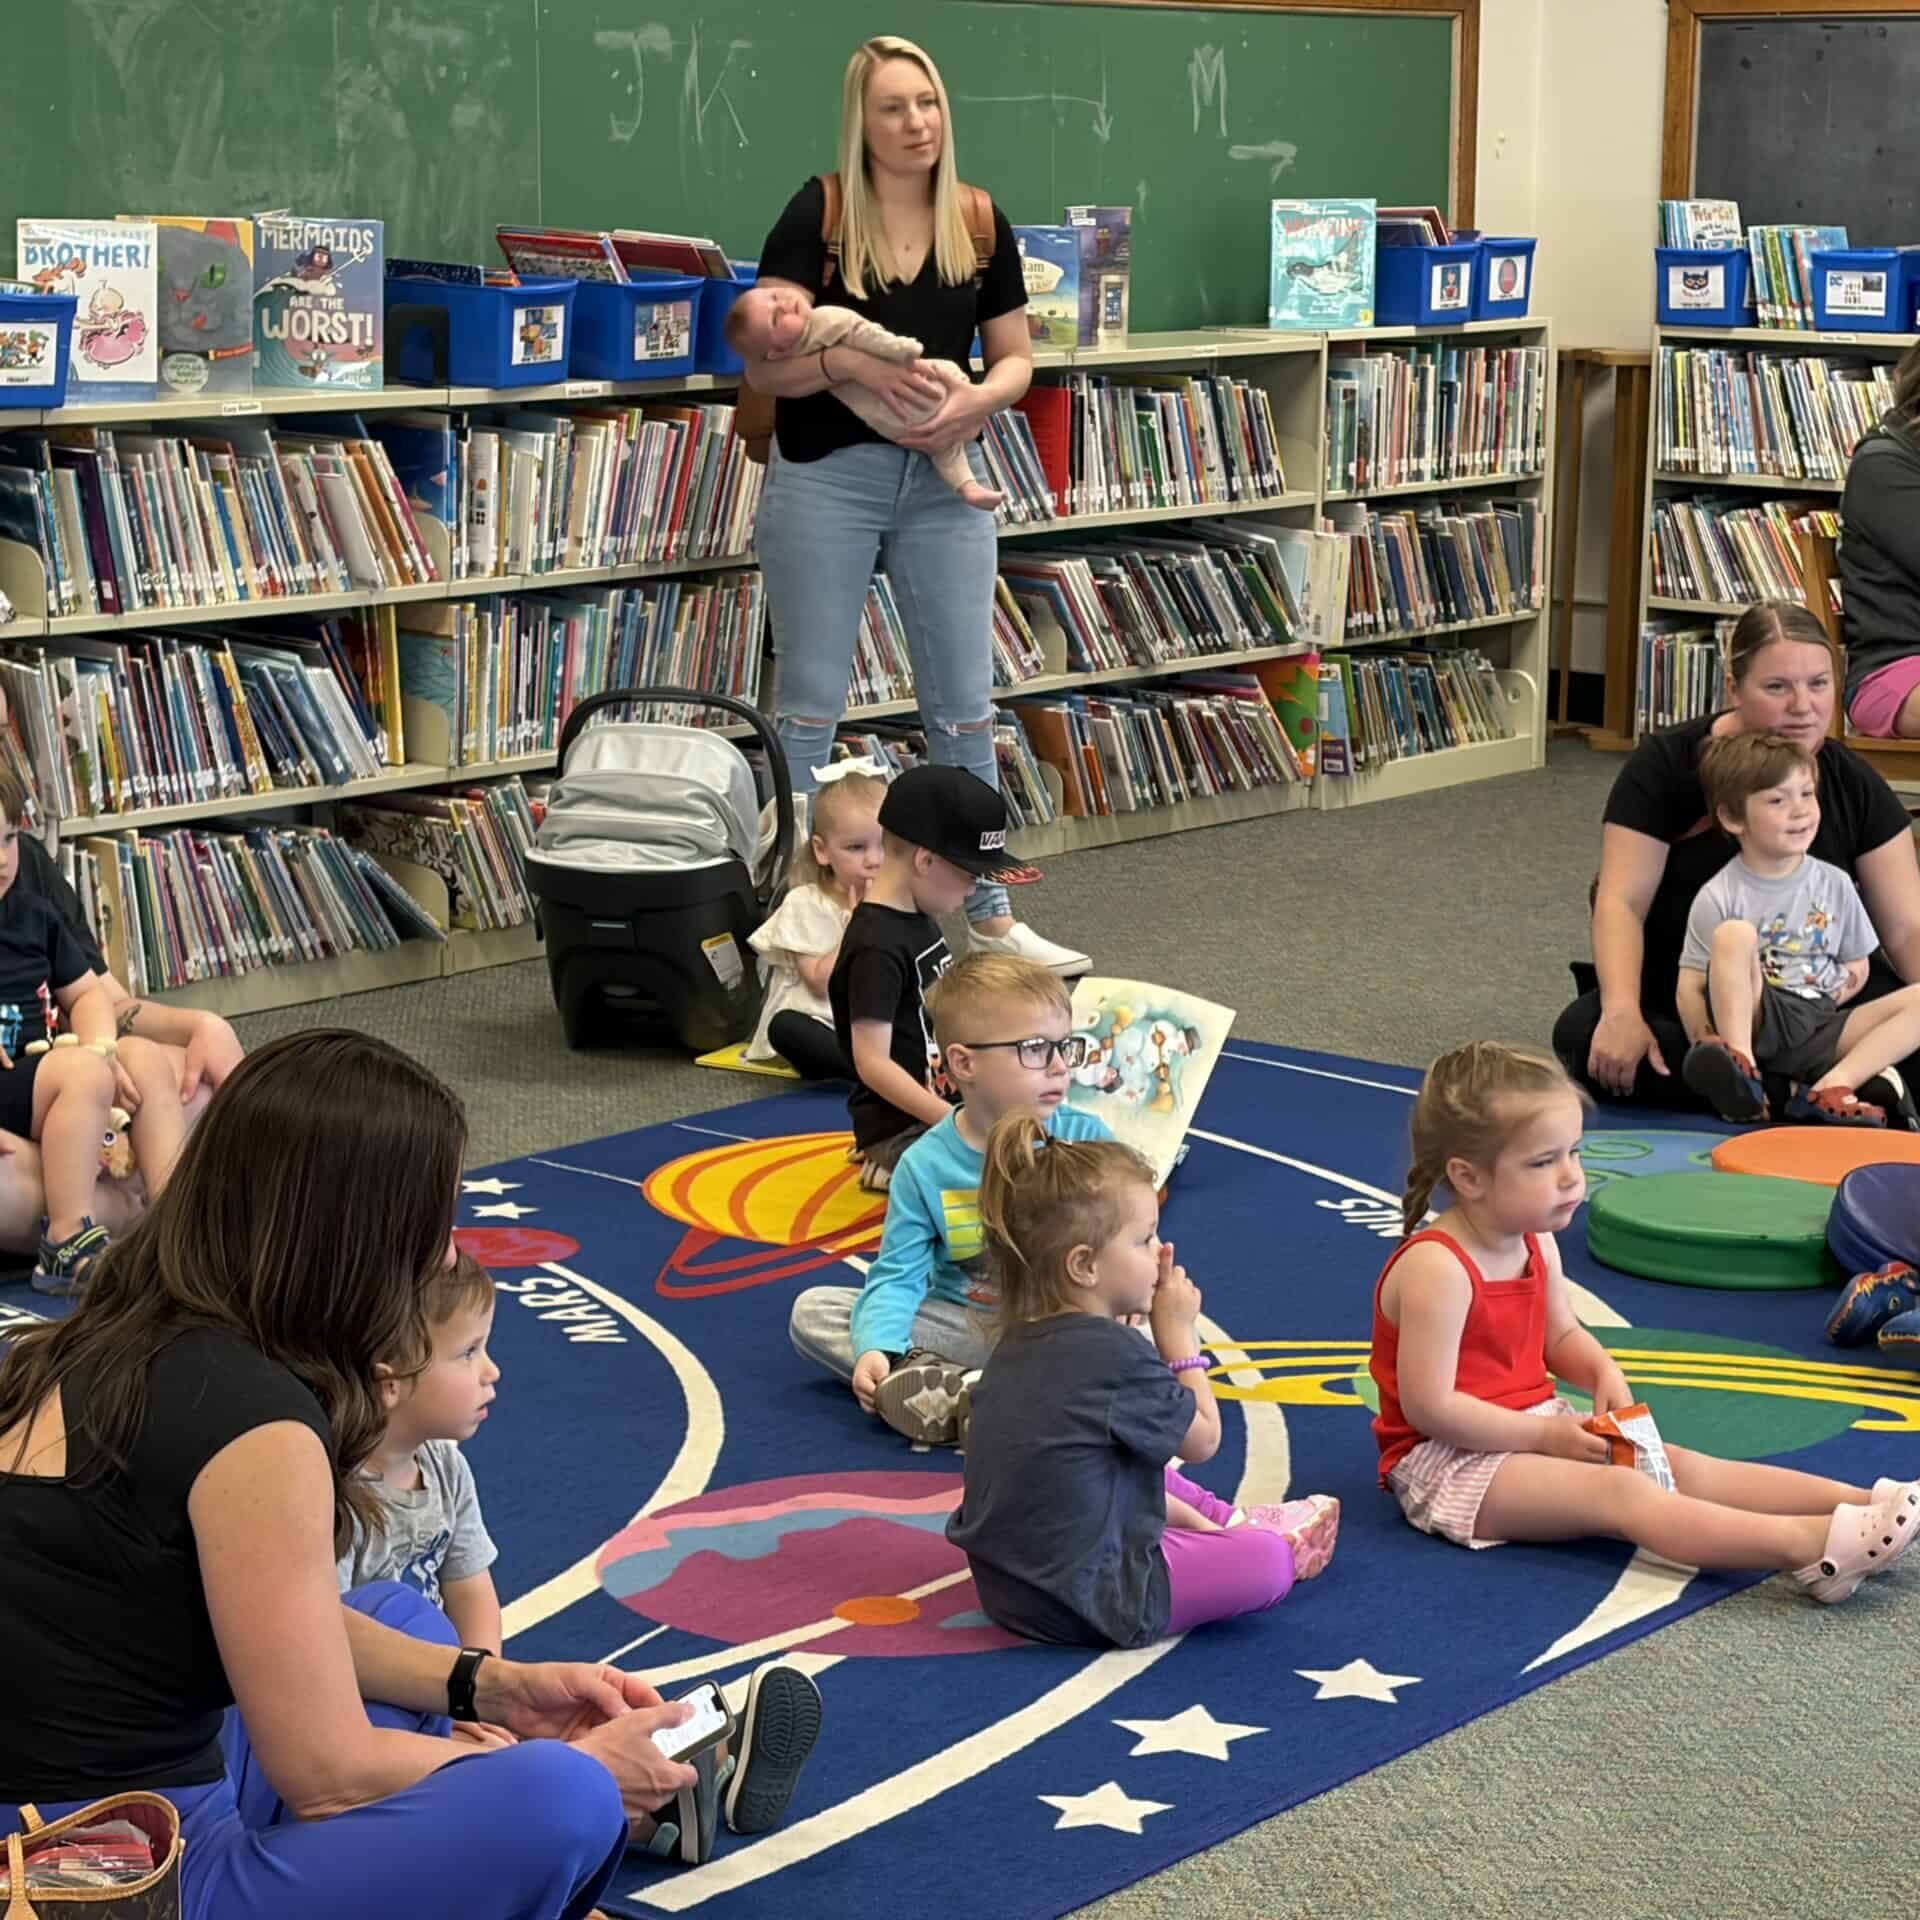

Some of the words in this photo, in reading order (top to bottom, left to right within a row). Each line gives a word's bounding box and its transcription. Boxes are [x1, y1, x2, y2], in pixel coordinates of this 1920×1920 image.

[24, 242, 150, 269] BROTHER!
[260, 222, 374, 257] MERMAIDS
[289, 296, 313, 309] ARE
[319, 297, 345, 310] THE
[261, 308, 374, 346] WORST!
[494, 1276, 629, 1343] MARS
